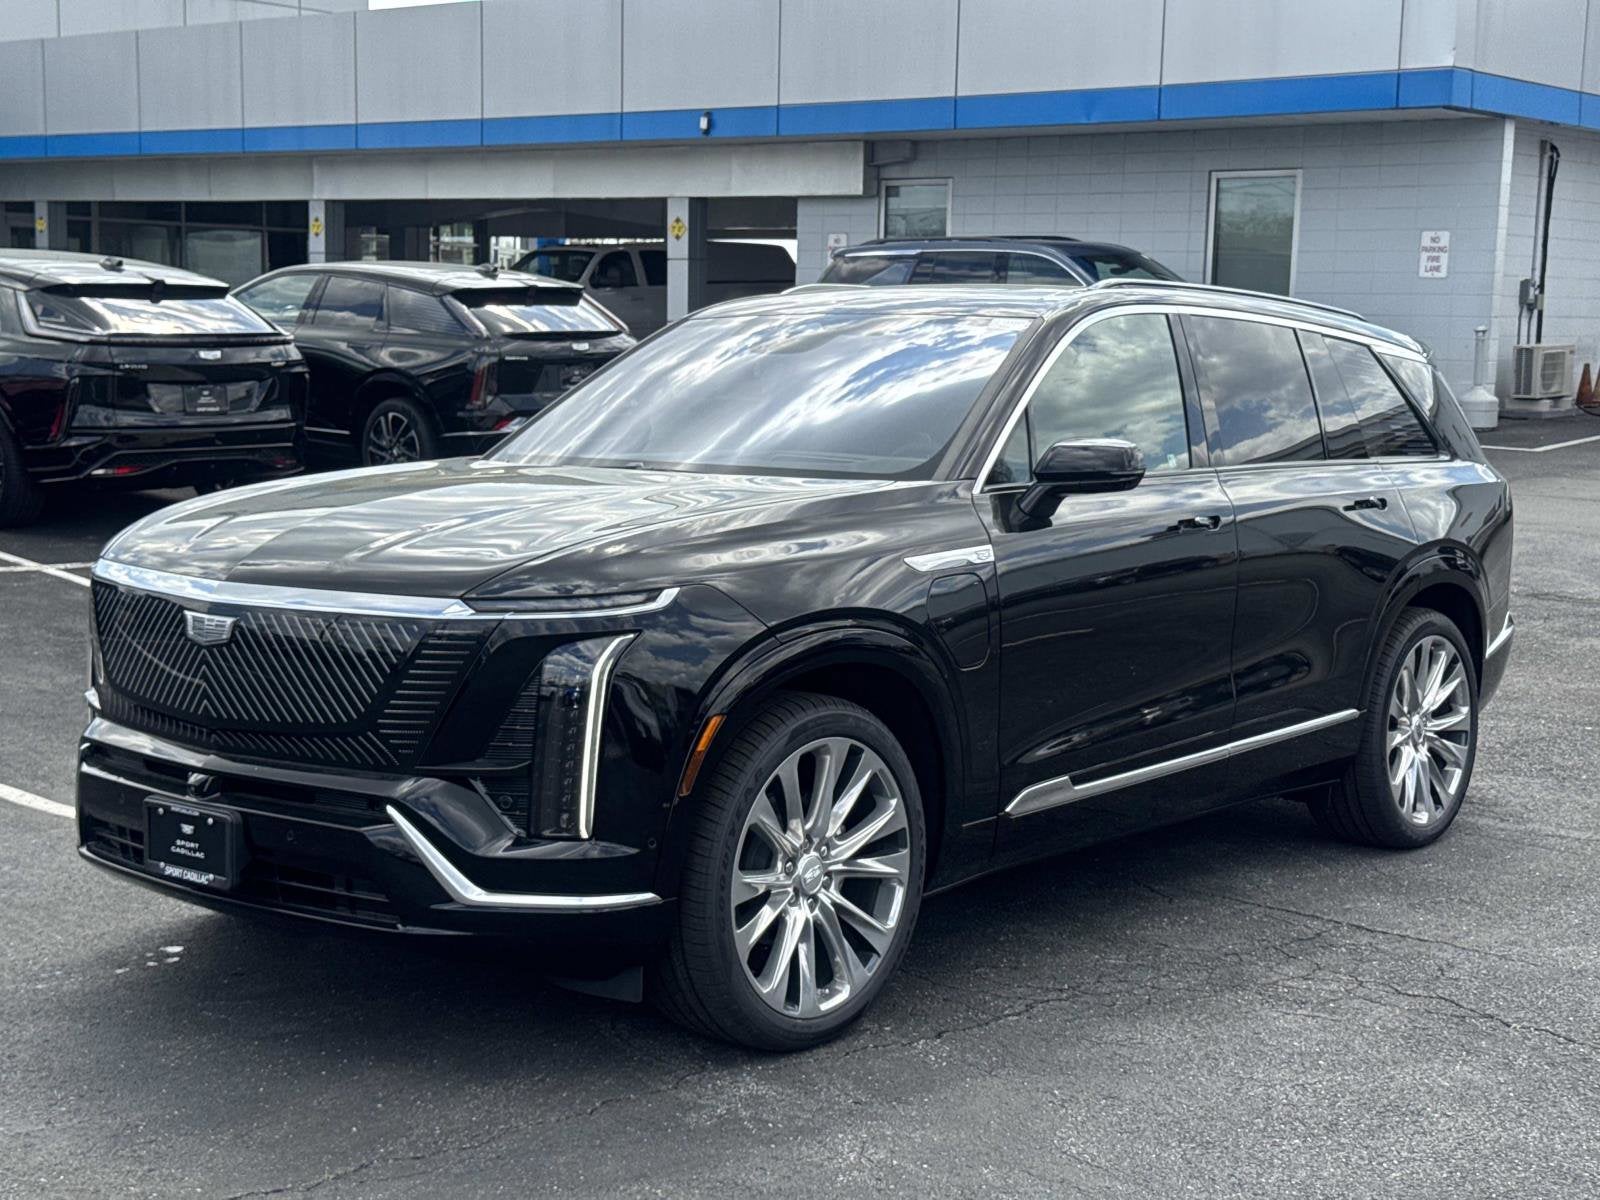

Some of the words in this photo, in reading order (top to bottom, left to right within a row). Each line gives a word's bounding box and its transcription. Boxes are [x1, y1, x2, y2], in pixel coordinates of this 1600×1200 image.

[1430, 235, 1441, 244] NO
[1421, 245, 1448, 253] PARKING
[1427, 255, 1441, 263] FIRE
[1424, 265, 1442, 273] LANE
[176, 839, 199, 849] SPORT
[170, 846, 205, 859] CADILLAC
[164, 866, 182, 878] SPORT
[183, 870, 209, 885] CADILLAC
